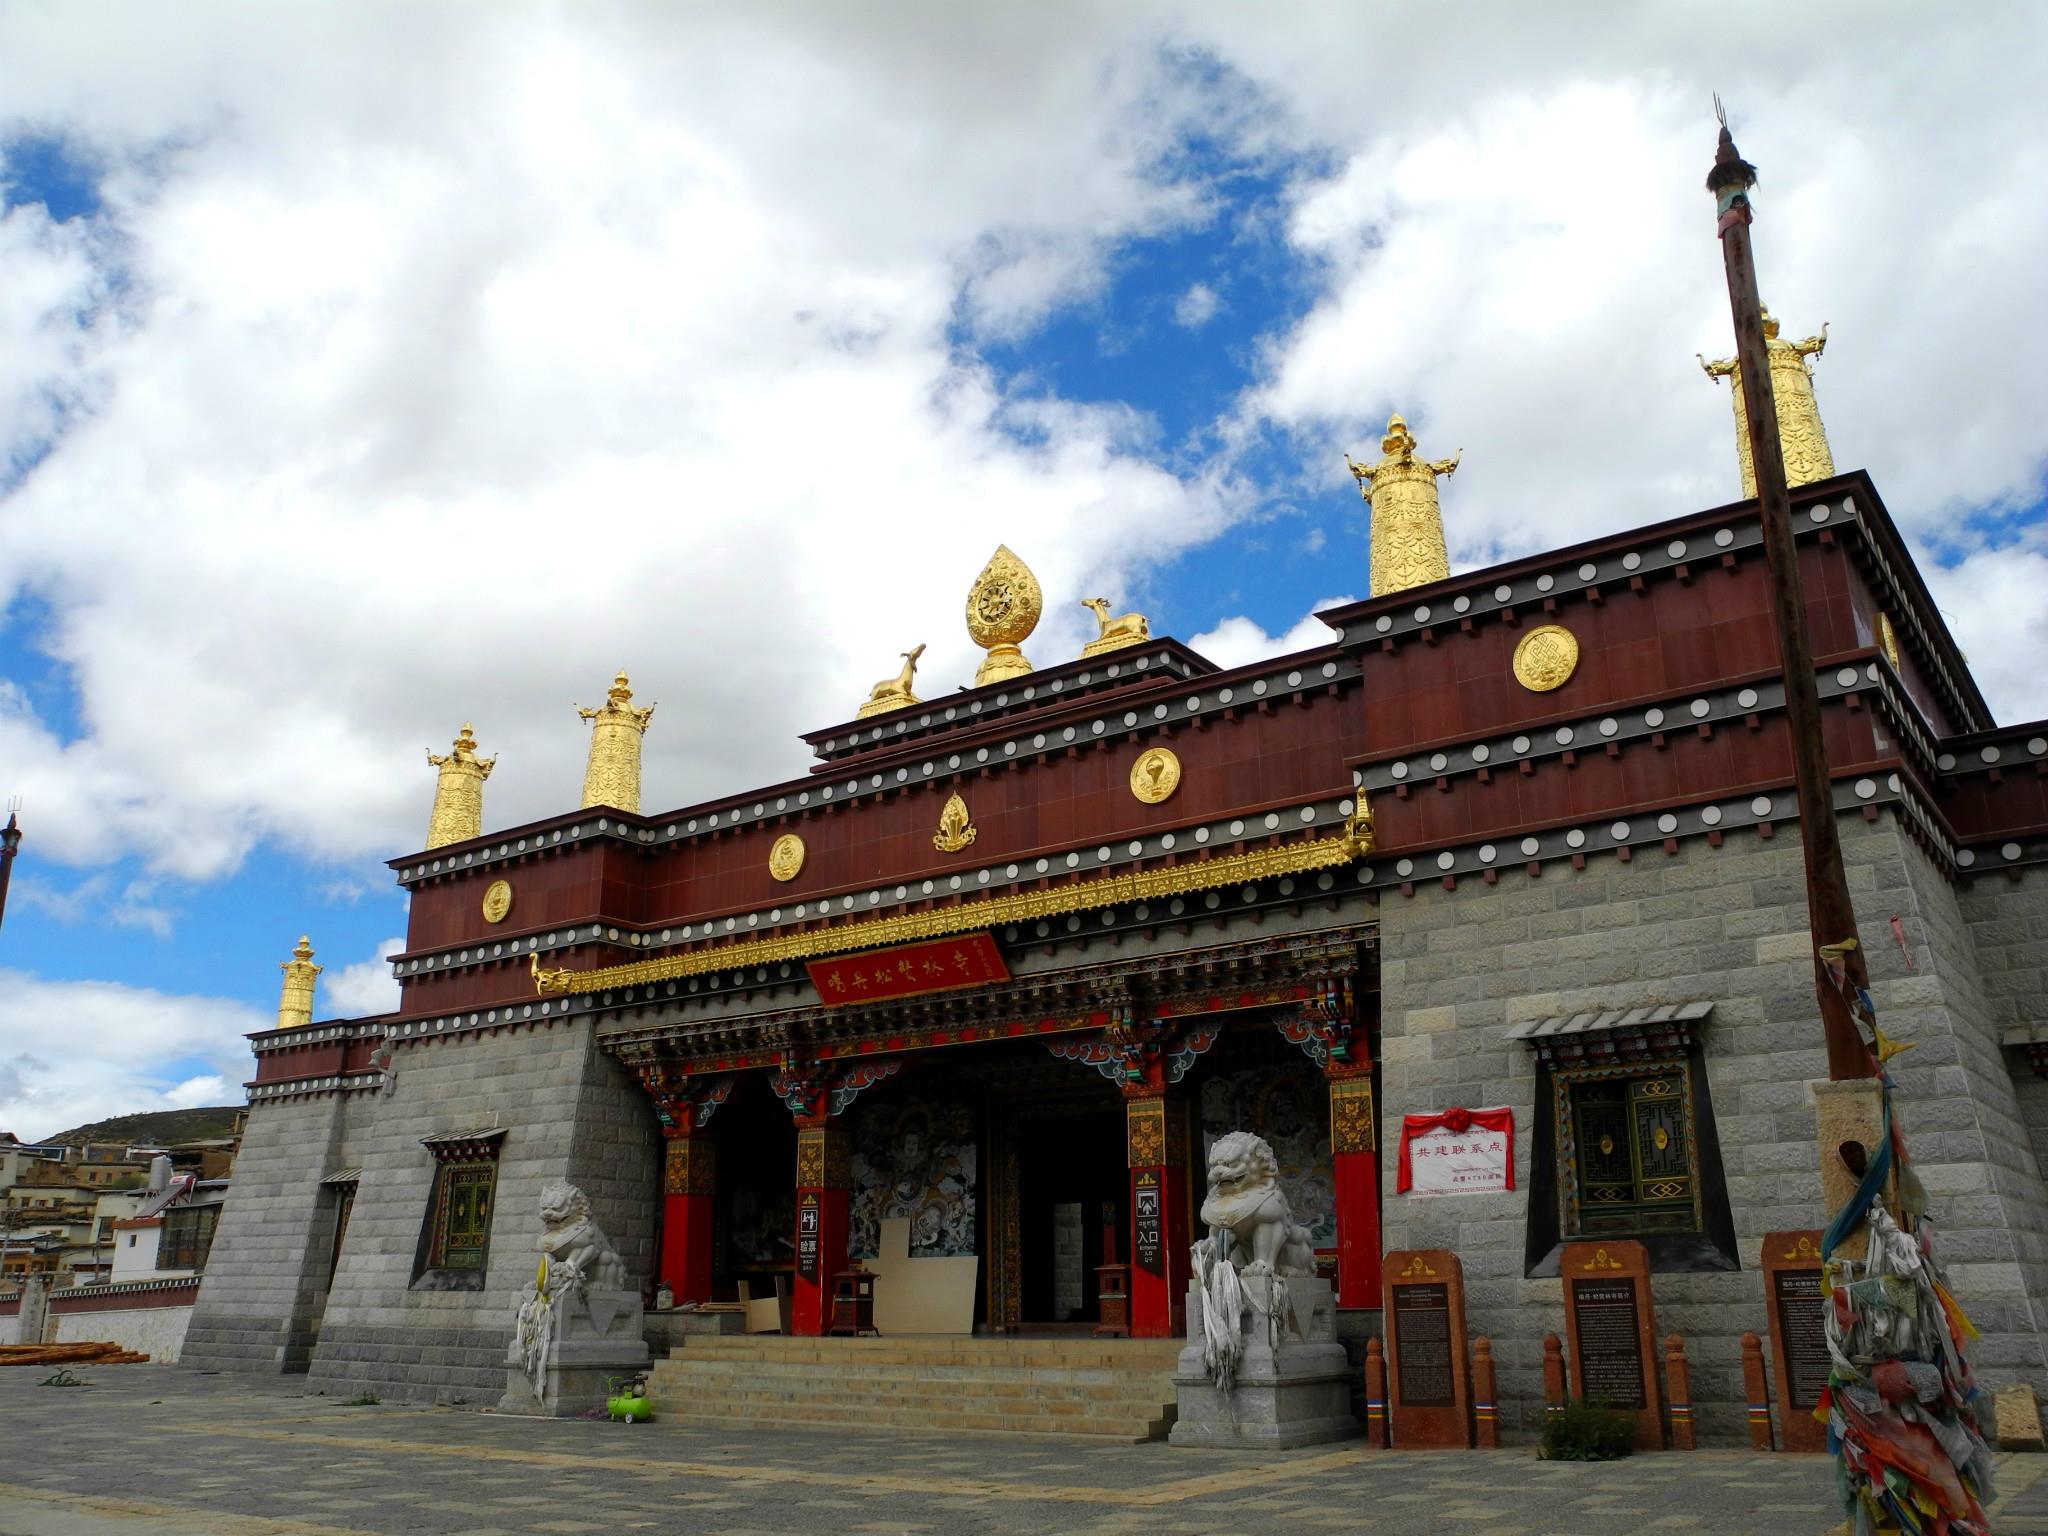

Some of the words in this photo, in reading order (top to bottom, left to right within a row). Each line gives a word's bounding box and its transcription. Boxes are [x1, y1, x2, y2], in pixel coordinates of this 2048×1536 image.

[1416, 1141, 1503, 1158] 共建联系点
[1138, 1231, 1158, 1244] 入口
